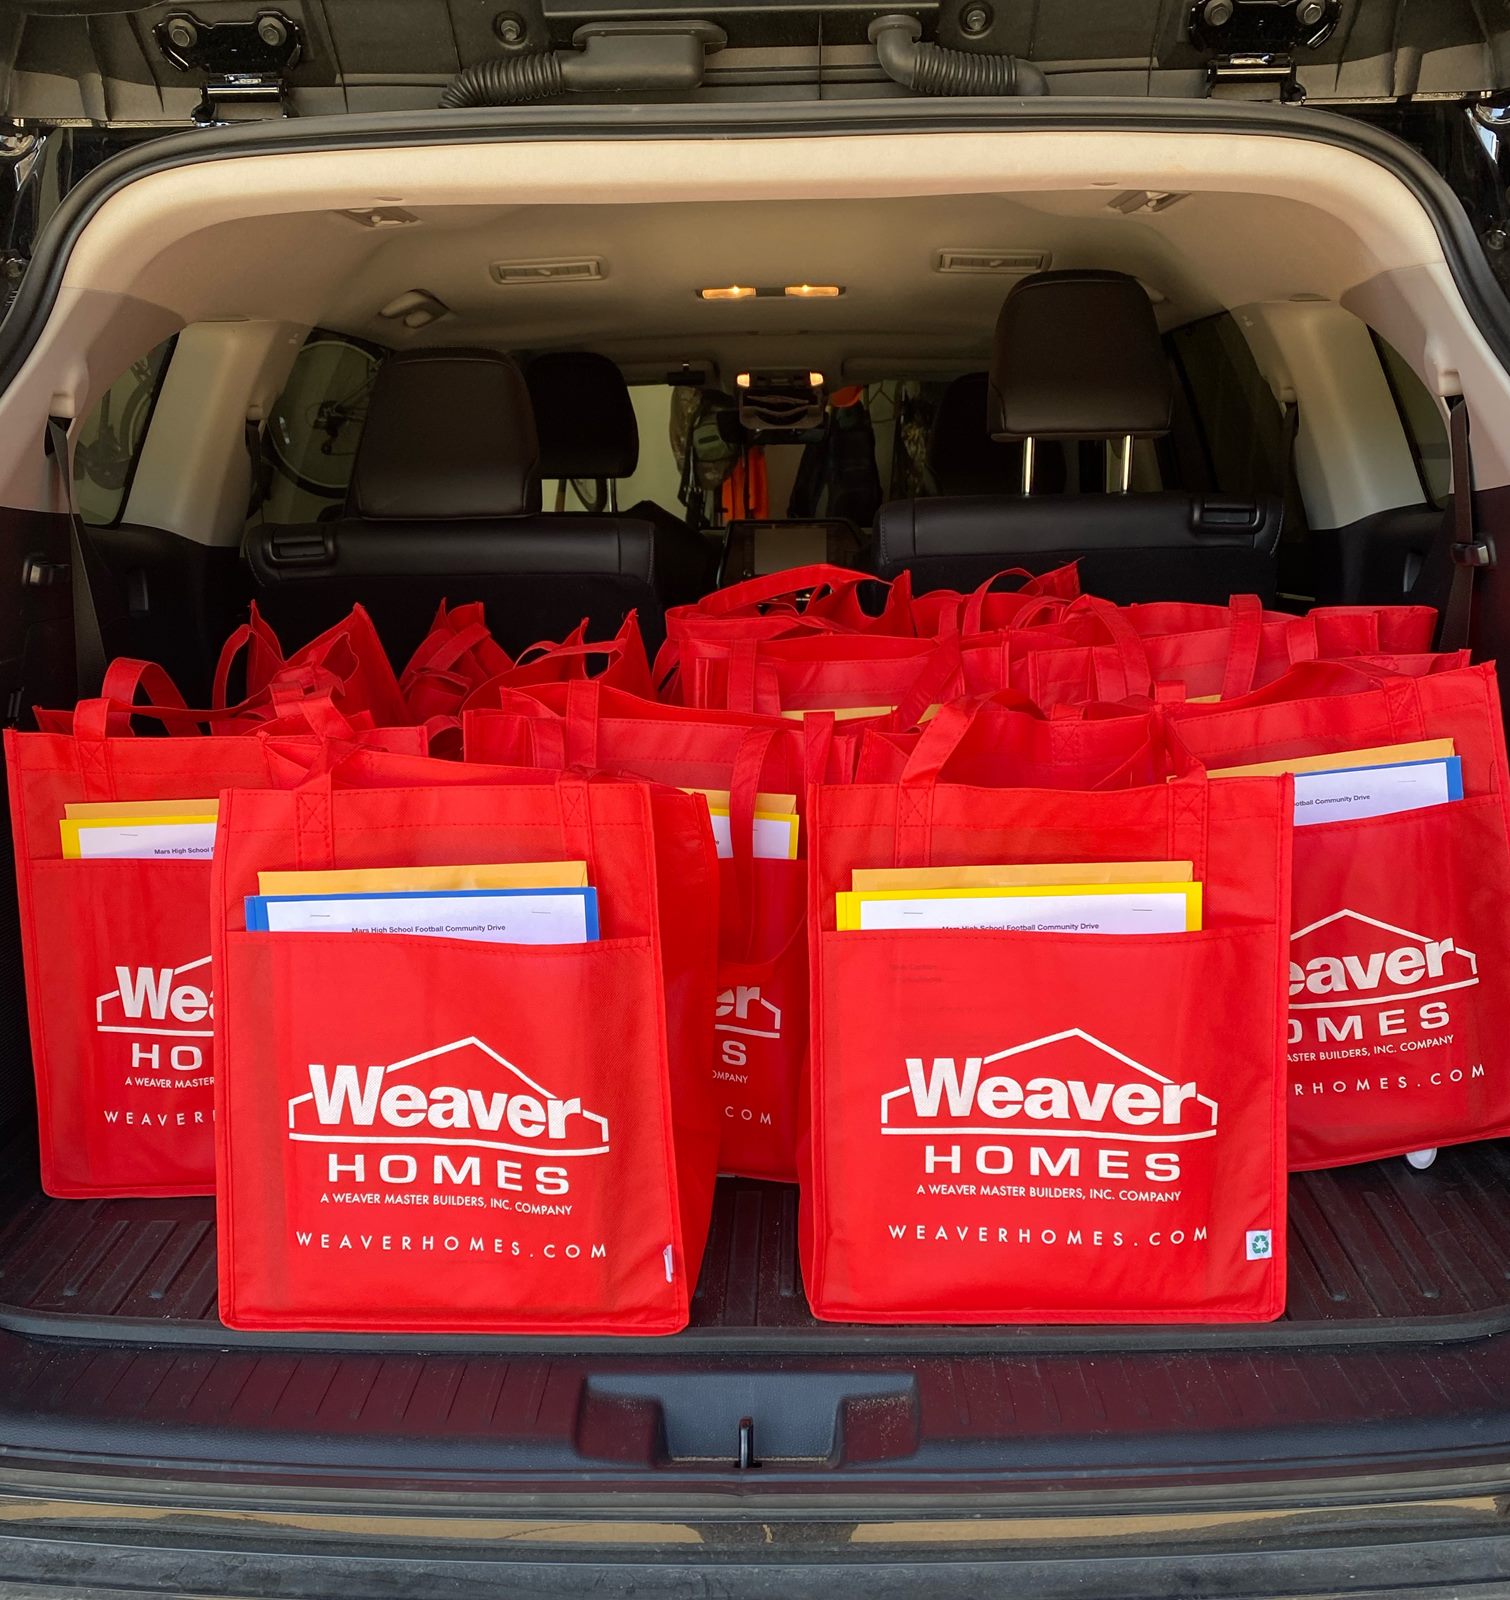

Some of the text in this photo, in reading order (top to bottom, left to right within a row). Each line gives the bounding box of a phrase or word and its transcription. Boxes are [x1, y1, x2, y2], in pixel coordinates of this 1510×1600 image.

[1314, 795, 1352, 805] Community
[445, 924, 486, 933] Community
[1037, 924, 1079, 932] Community
[115, 966, 213, 1022] We
[132, 1043, 202, 1070] HO
[722, 1040, 747, 1066] S
[1320, 1048, 1370, 1060] BUILDERS,
[1374, 1044, 1396, 1054] INC.
[1400, 1034, 1454, 1052] COMPANY
[124, 1076, 214, 1088] A WEAVER MASTER
[905, 1057, 1196, 1126] Weaver
[308, 1064, 581, 1139] Weaver
[328, 1153, 569, 1195] HOMES
[926, 1146, 1180, 1181] HOMES
[320, 1192, 572, 1216] A WEAVER MASTER BUILDERS, INC. COMPANY
[916, 1184, 1180, 1202] A WEAVER MASTER BUILDERS, INC. COMPANY
[296, 1232, 605, 1258] WEAVERHOMES.COM
[888, 1224, 1206, 1246] WEAVERHOMES.COM
